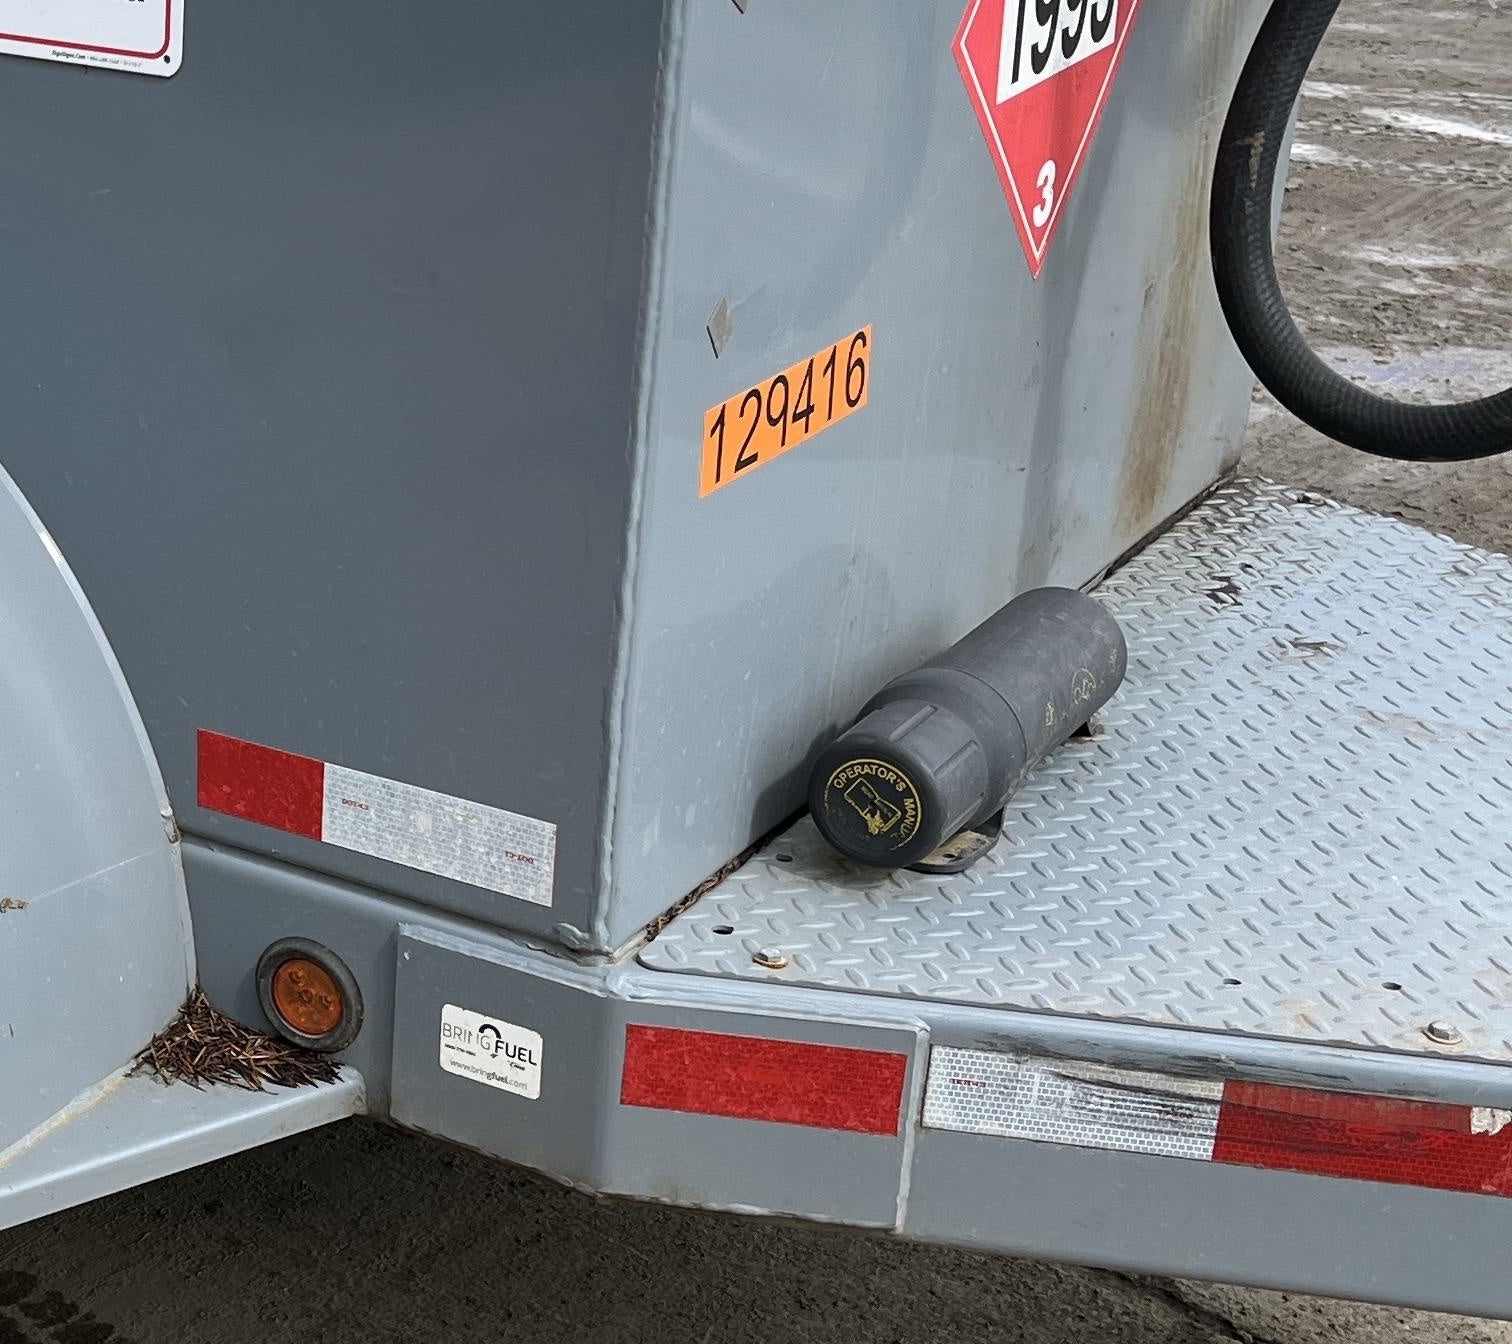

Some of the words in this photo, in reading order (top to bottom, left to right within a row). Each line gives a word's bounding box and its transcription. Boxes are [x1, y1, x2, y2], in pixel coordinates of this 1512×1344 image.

[1033, 159, 1057, 228] 3
[709, 331, 868, 484] 129416
[833, 764, 907, 792] OPERATOR'S
[494, 1039, 538, 1067] FUEL
[450, 1059, 528, 1091] www.bringfuel.com
